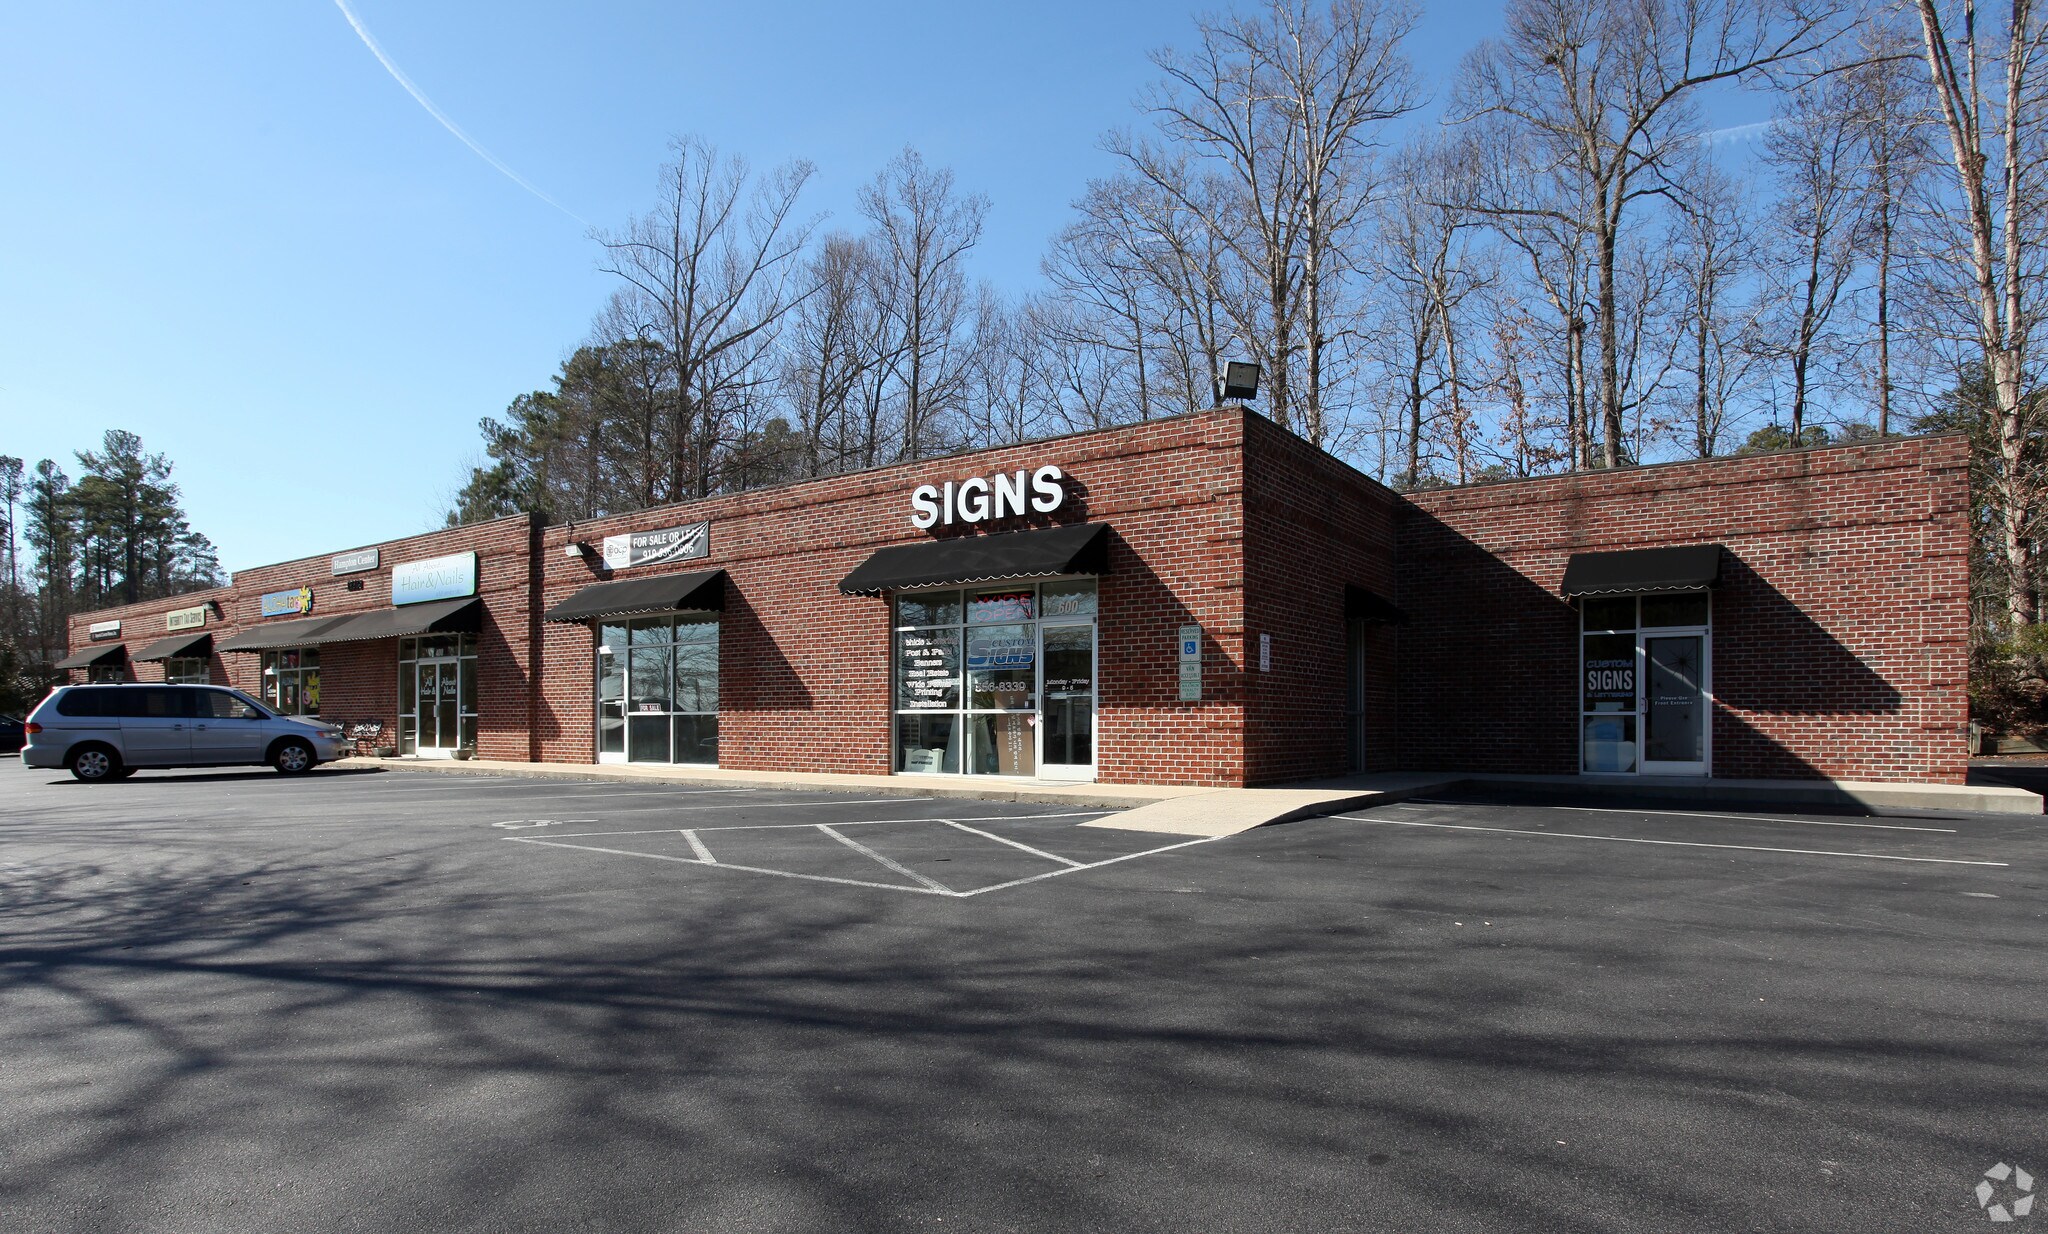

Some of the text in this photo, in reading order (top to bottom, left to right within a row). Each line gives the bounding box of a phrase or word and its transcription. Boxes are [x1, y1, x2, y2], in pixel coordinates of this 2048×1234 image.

[911, 465, 1065, 529] SIGNS
[633, 537, 647, 548] FOR
[649, 533, 667, 546] SALE
[669, 531, 679, 543] OR
[334, 554, 375, 570] Hampton Center
[976, 594, 1031, 606] WIDE
[1058, 600, 1079, 613] 600
[976, 607, 1031, 621] OPEN
[991, 638, 1035, 647] CUSTOM
[967, 639, 1036, 665] SIGNS
[913, 659, 942, 667] Banners
[1586, 659, 1633, 668] CUSTOM
[1588, 669, 1633, 691] SIGNS
[914, 688, 943, 697] Printing
[909, 700, 947, 708] Installation
